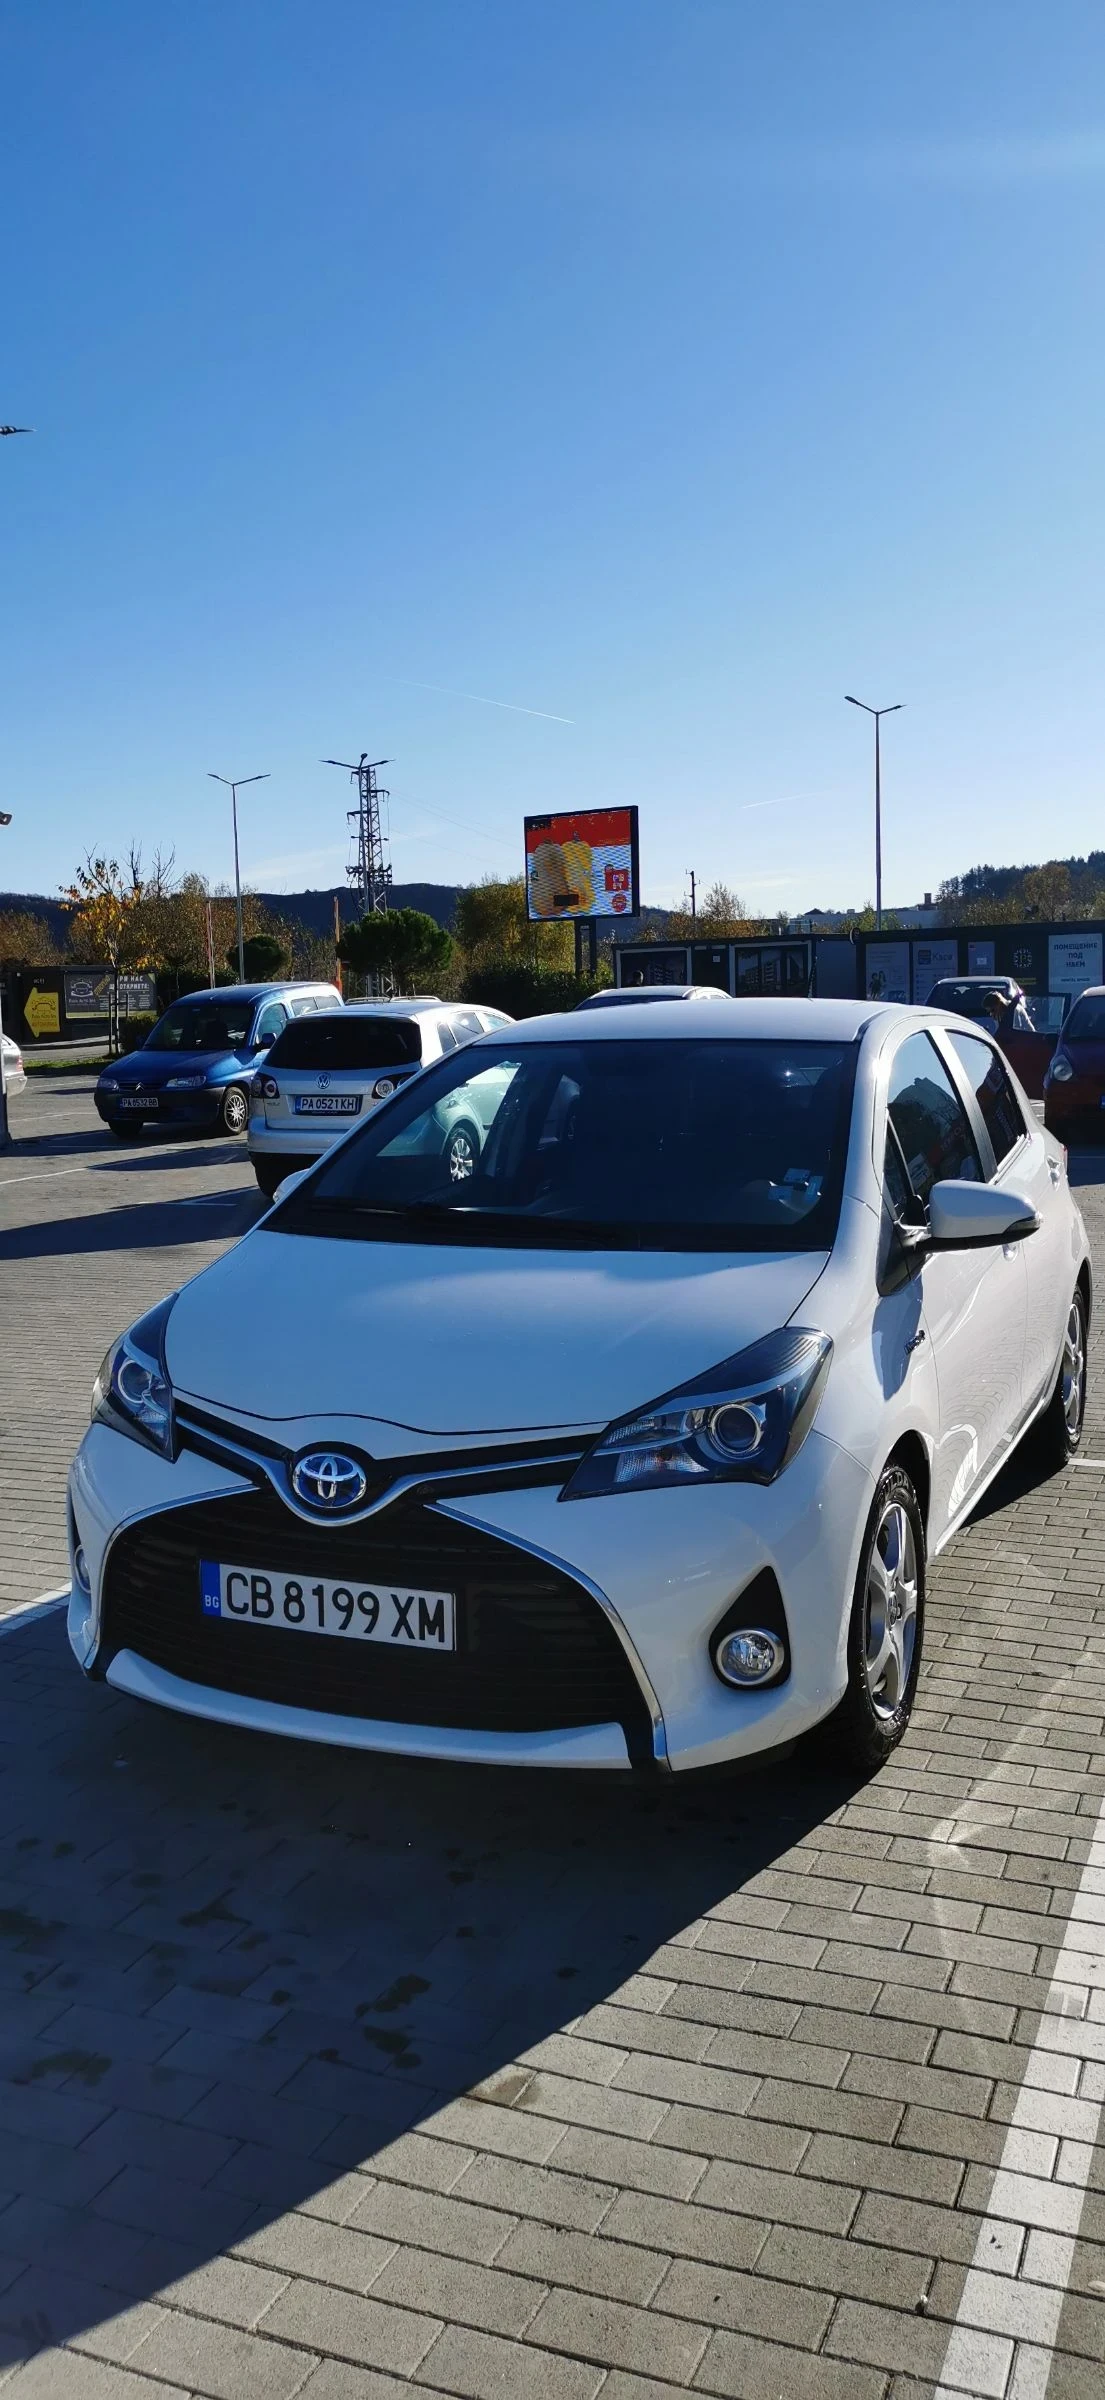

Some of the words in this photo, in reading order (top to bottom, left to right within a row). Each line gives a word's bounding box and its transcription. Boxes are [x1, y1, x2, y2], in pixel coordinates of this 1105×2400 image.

[1054, 942, 1098, 951] ПОМЕЩЕНИЕ
[1068, 952, 1083, 960] ПОД
[1065, 960, 1086, 968] НАЕМ
[301, 1098, 314, 1110] PA
[315, 1098, 339, 1110] 0521
[340, 1098, 354, 1110] KH
[204, 1594, 219, 1609] BG
[226, 1572, 275, 1619] CB
[283, 1580, 380, 1634] 8199
[390, 1593, 445, 1643] XM
